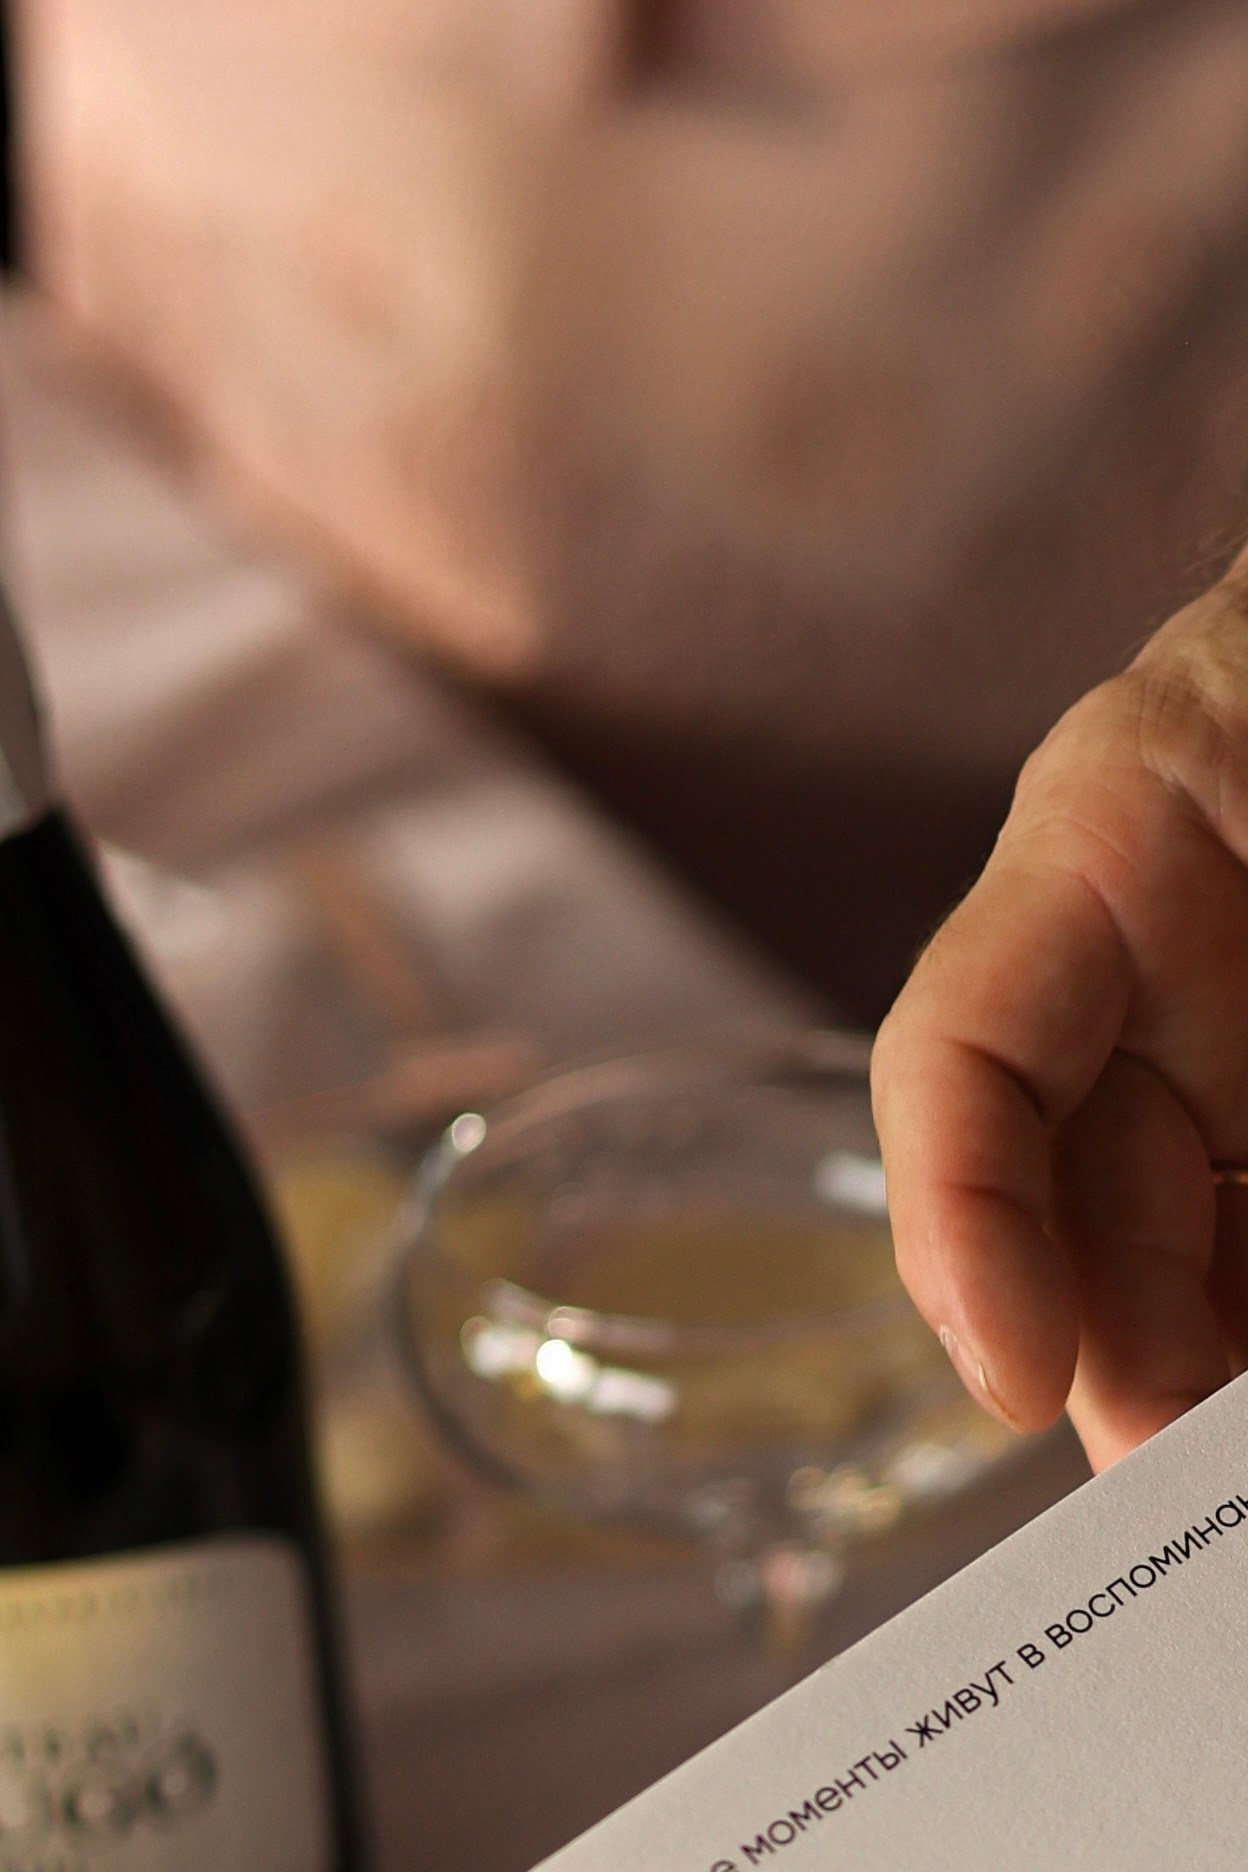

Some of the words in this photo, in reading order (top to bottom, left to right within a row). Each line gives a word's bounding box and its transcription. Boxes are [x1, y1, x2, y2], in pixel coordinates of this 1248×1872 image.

[739, 1738, 910, 1866] моменты
[904, 1659, 1015, 1750] живут
[1016, 1642, 1047, 1670] в
